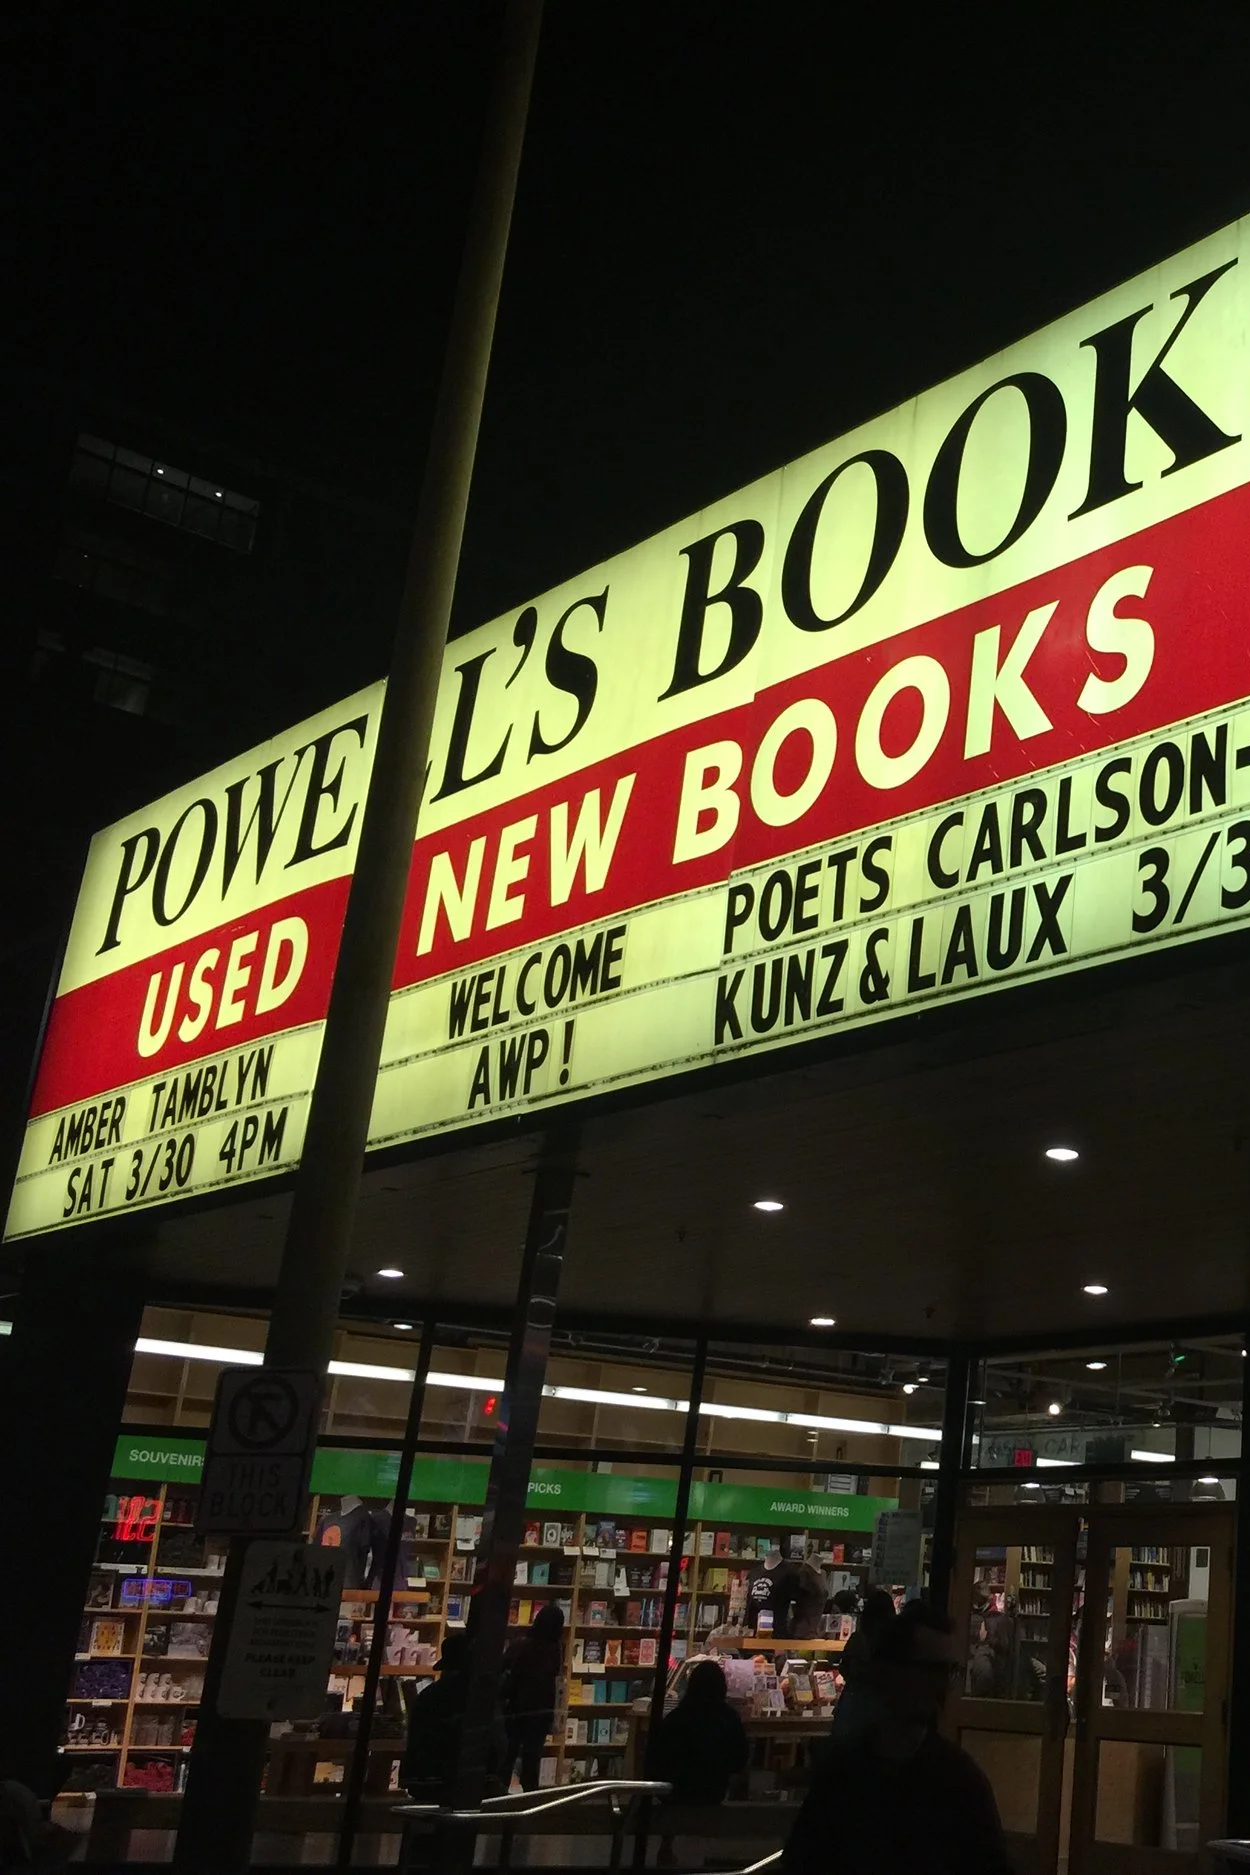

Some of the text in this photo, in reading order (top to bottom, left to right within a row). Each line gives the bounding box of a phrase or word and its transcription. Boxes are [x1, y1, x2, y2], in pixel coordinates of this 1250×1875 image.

[96, 585, 609, 956] POWEL'S
[137, 565, 1156, 1059] USED NEW BOOKS
[723, 836, 893, 955] POETS
[448, 924, 627, 1040] WELCOME
[714, 940, 848, 1045] KUNZ
[908, 874, 1075, 995] LAUX
[49, 1044, 275, 1164] AMBER TAMBLYN
[467, 1020, 576, 1110] AWP!
[63, 1105, 288, 1218] SAT 3/30 4PM
[210, 1491, 288, 1517] BLOCK
[229, 1462, 282, 1489] THIS
[528, 1481, 562, 1496] PICKS
[770, 1501, 850, 1517] AWARD WINNERS
